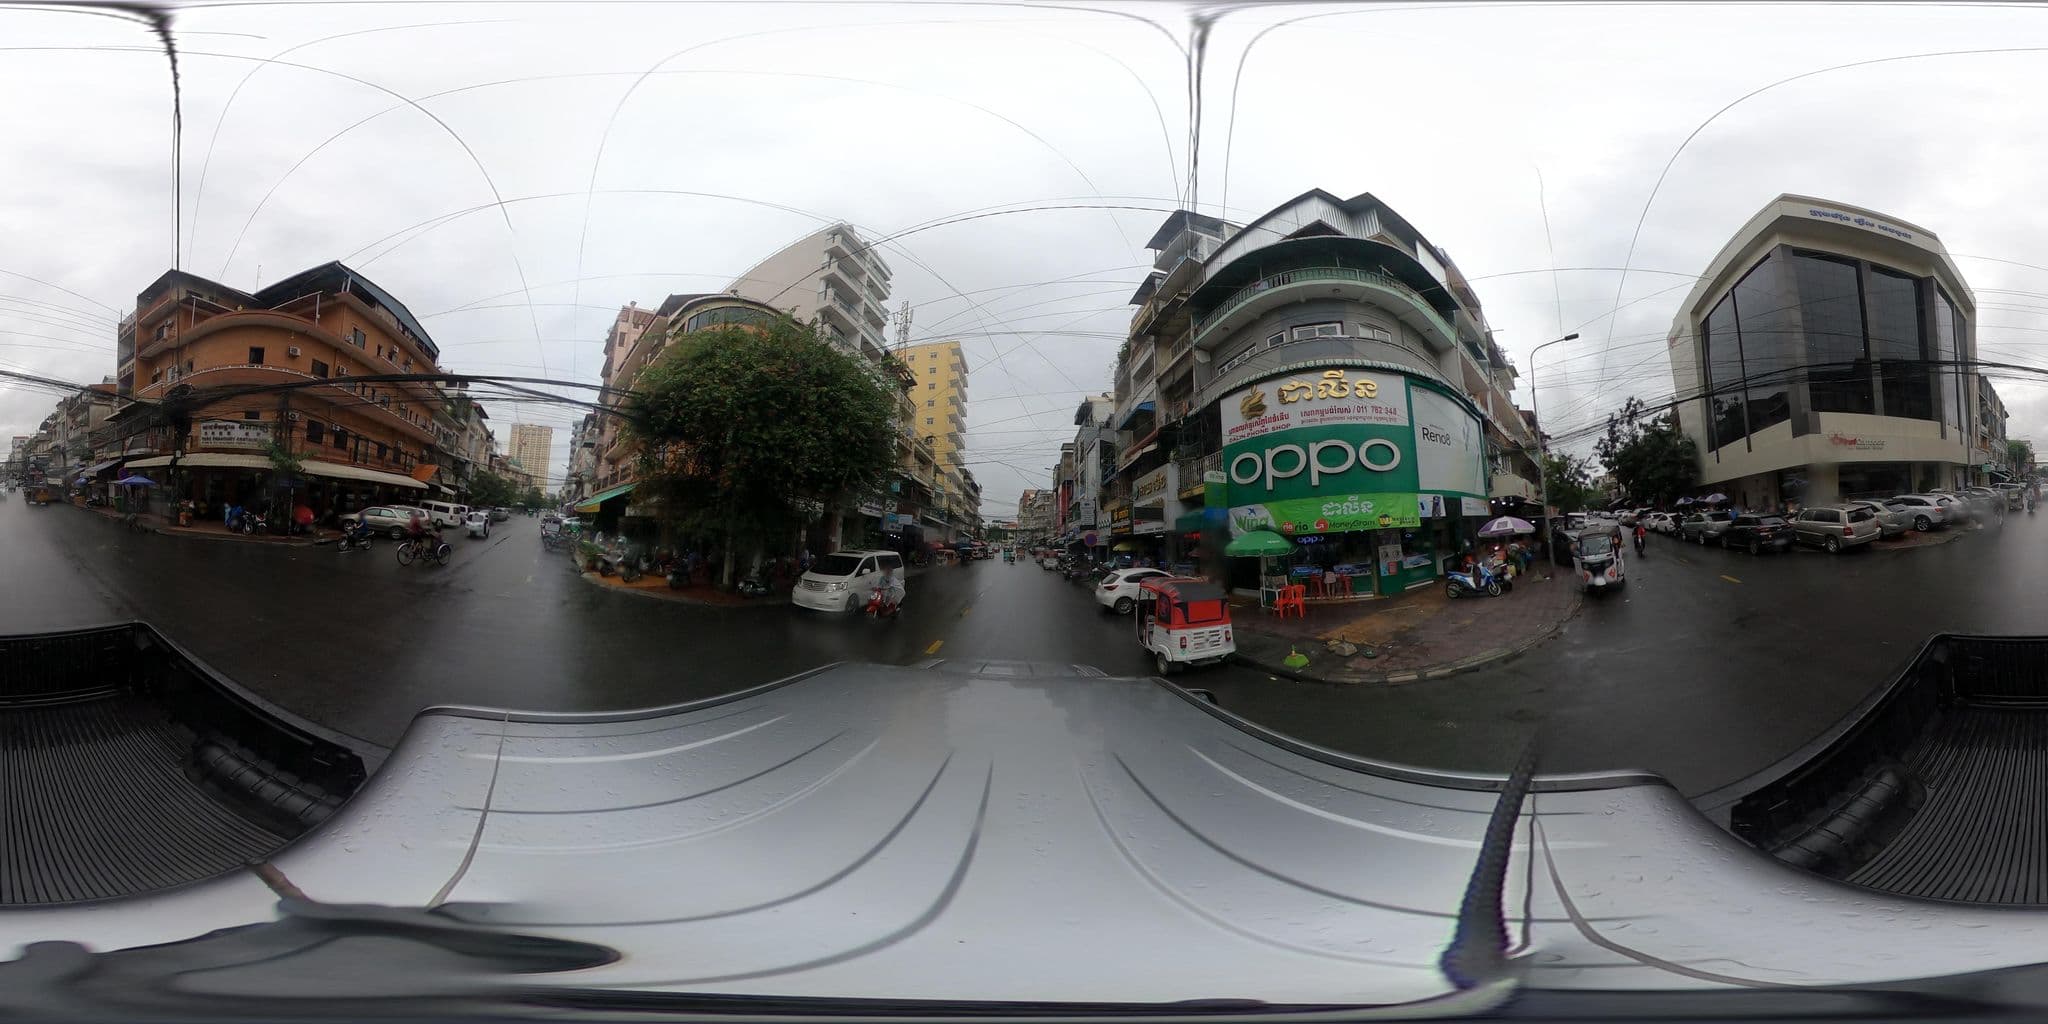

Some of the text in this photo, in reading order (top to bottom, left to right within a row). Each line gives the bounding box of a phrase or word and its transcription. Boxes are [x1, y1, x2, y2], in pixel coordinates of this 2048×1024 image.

[1246, 427, 1269, 438] PHONE
[1271, 422, 1291, 431] SHOP
[1421, 426, 1451, 446] Reno8
[1230, 438, 1401, 491] oppo
[1295, 521, 1309, 531] ria
[1328, 519, 1375, 529] MoneyGram
